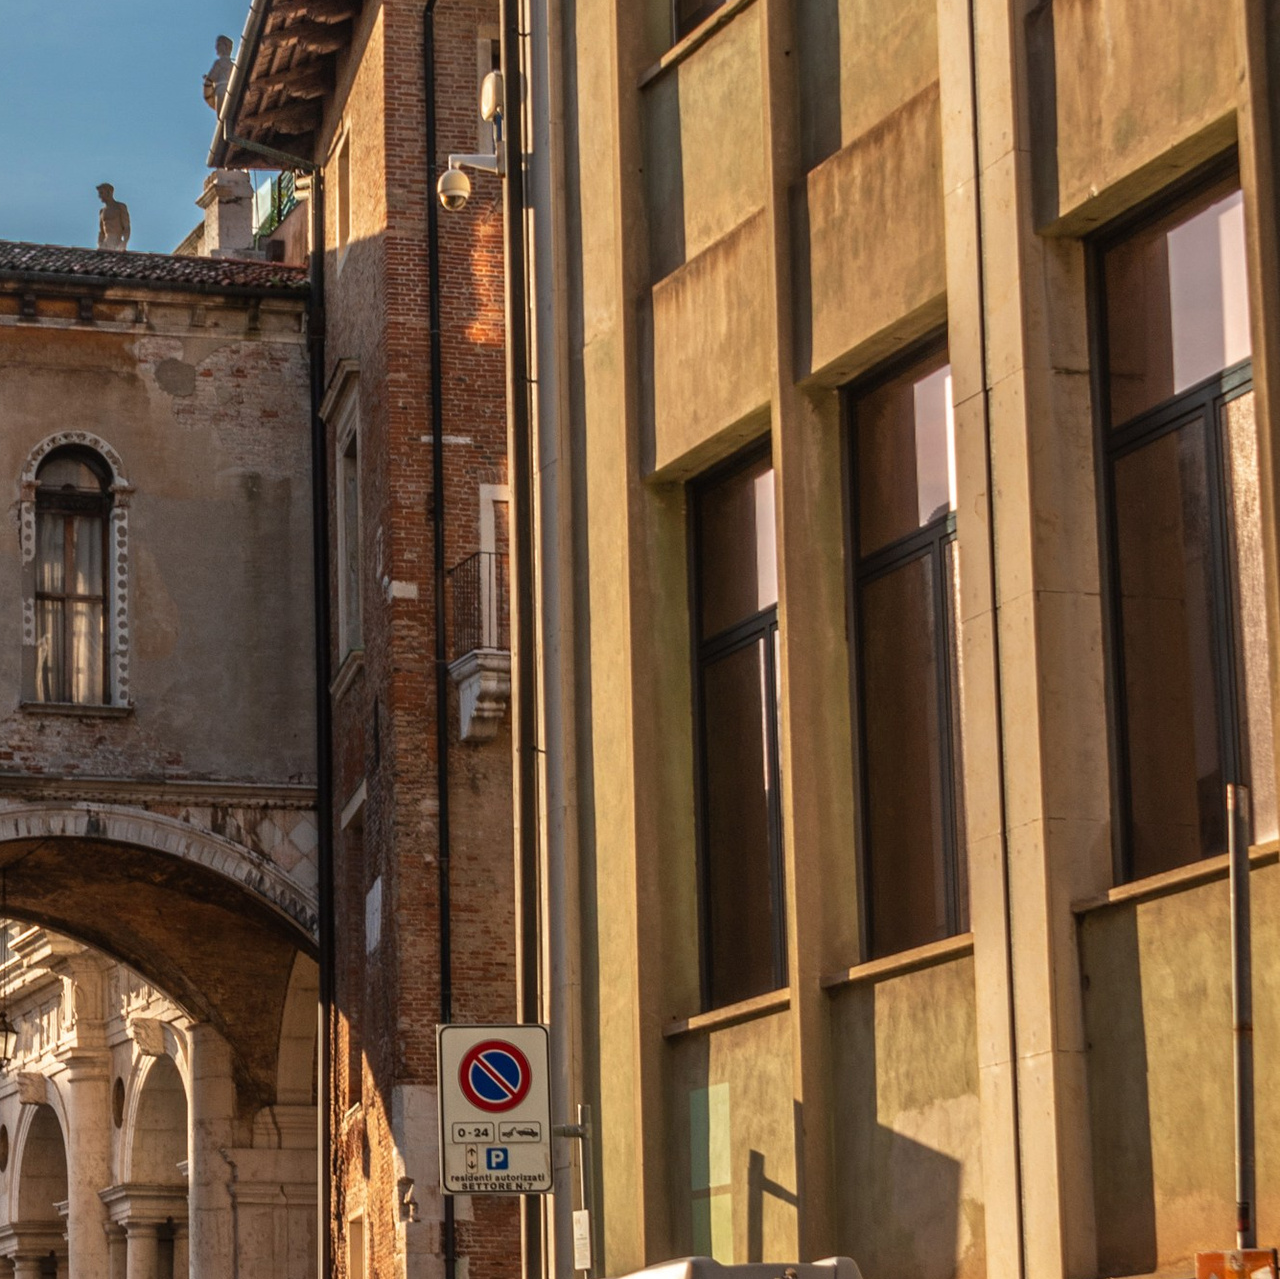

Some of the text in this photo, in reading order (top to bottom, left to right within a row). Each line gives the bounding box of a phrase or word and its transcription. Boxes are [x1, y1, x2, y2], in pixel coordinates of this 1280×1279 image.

[458, 1128, 466, 1138] 0
[474, 1128, 489, 1138] 24
[491, 1150, 505, 1168] P
[451, 1173, 545, 1182] residenti autorizzati
[462, 1182, 513, 1190] SETTORE
